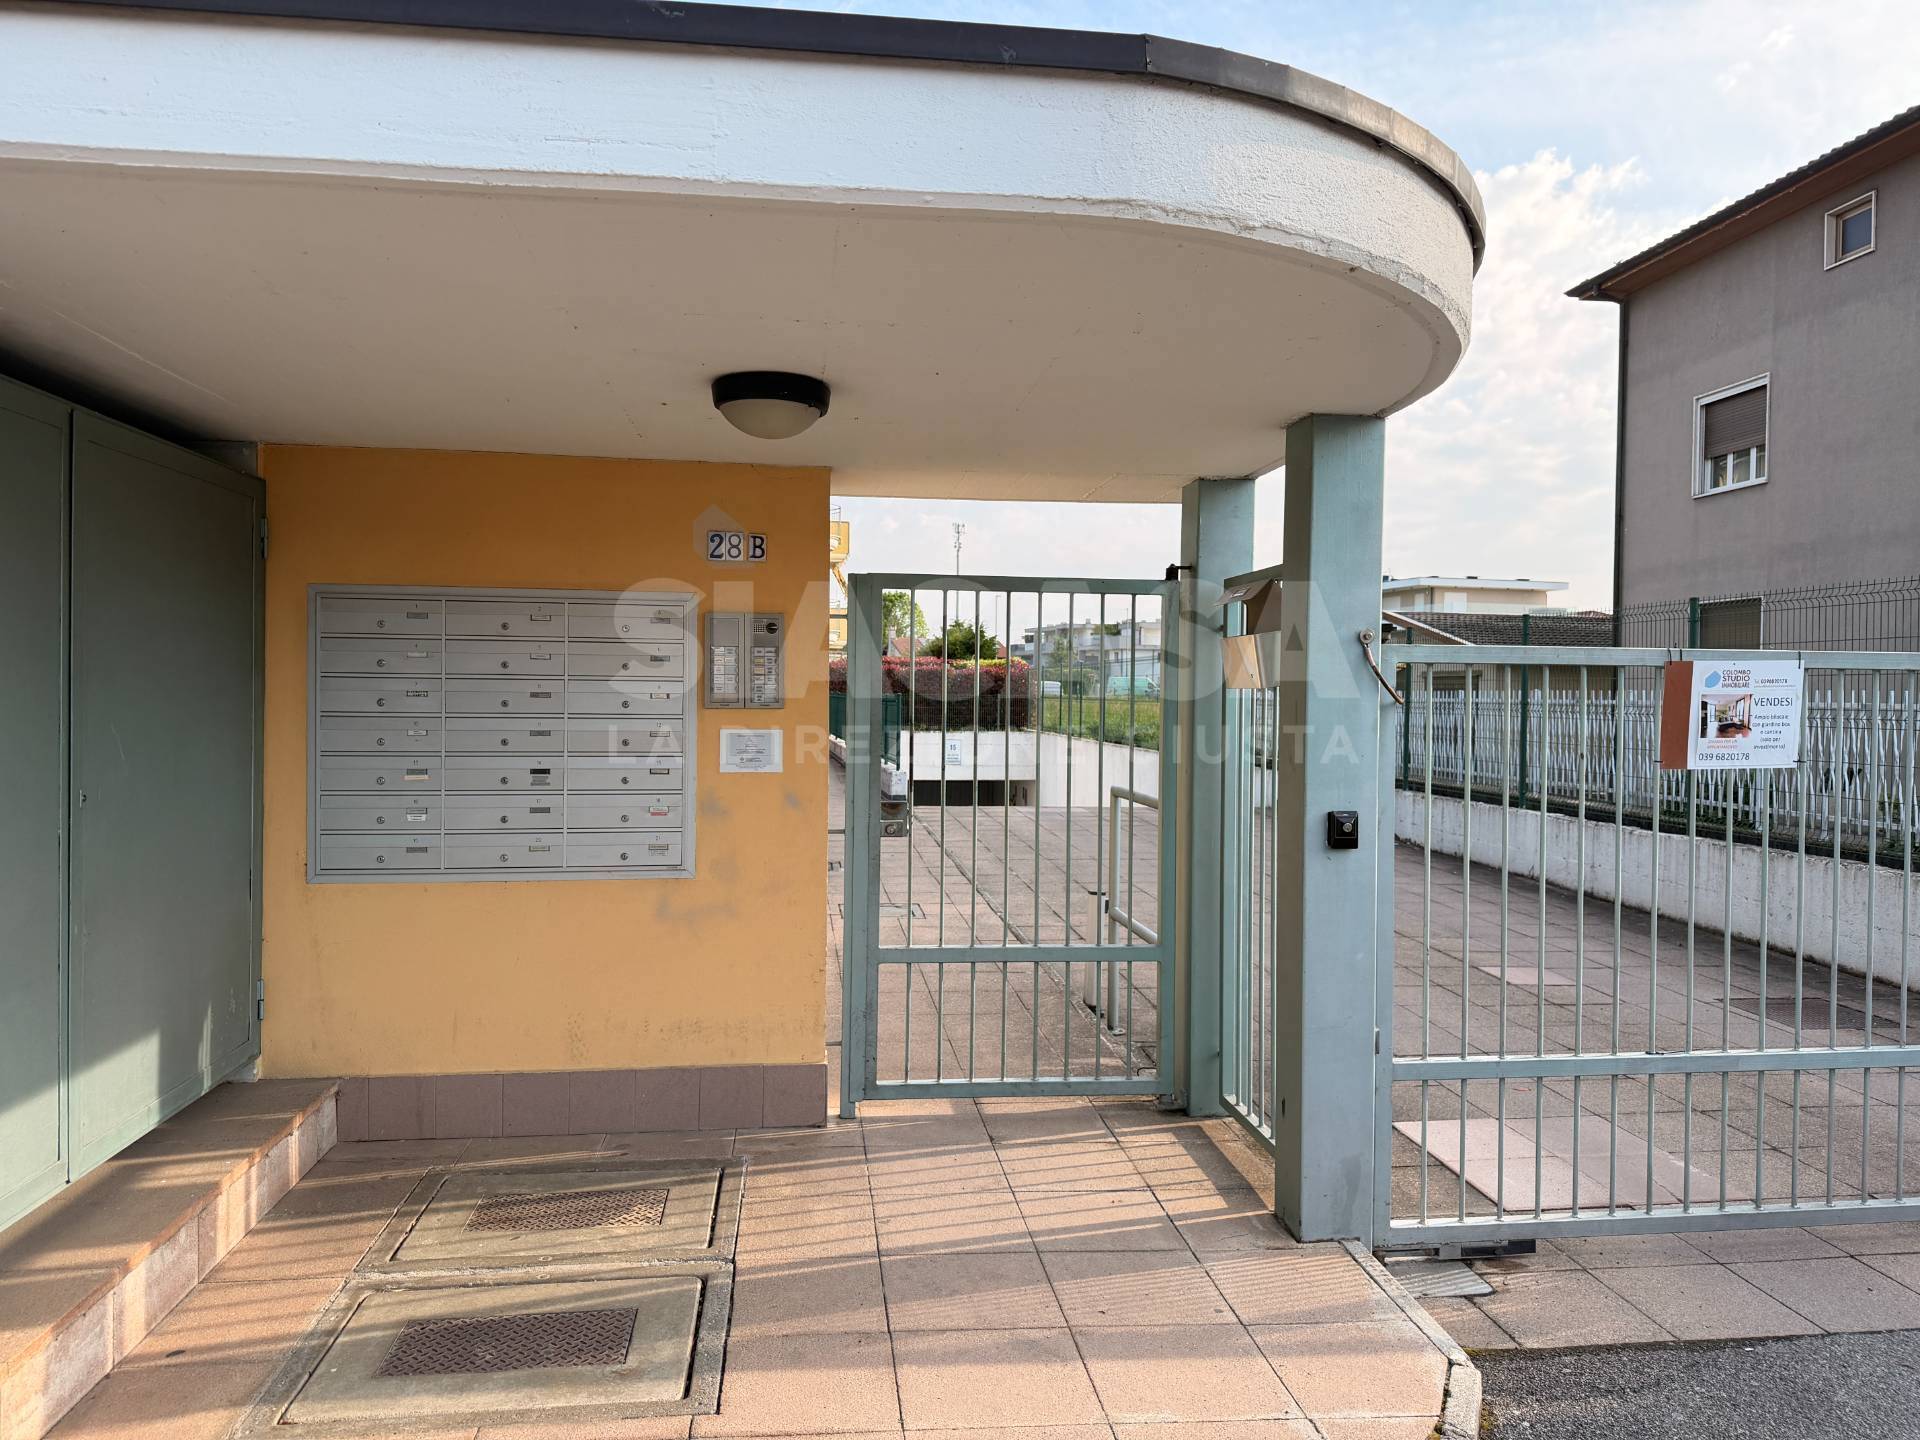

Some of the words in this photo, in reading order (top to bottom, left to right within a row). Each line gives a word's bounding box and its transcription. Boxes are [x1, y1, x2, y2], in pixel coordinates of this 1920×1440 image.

[1753, 697, 1793, 707] VENDESI
[1699, 752, 1714, 761] 039
[1715, 752, 1750, 761] 6820178
